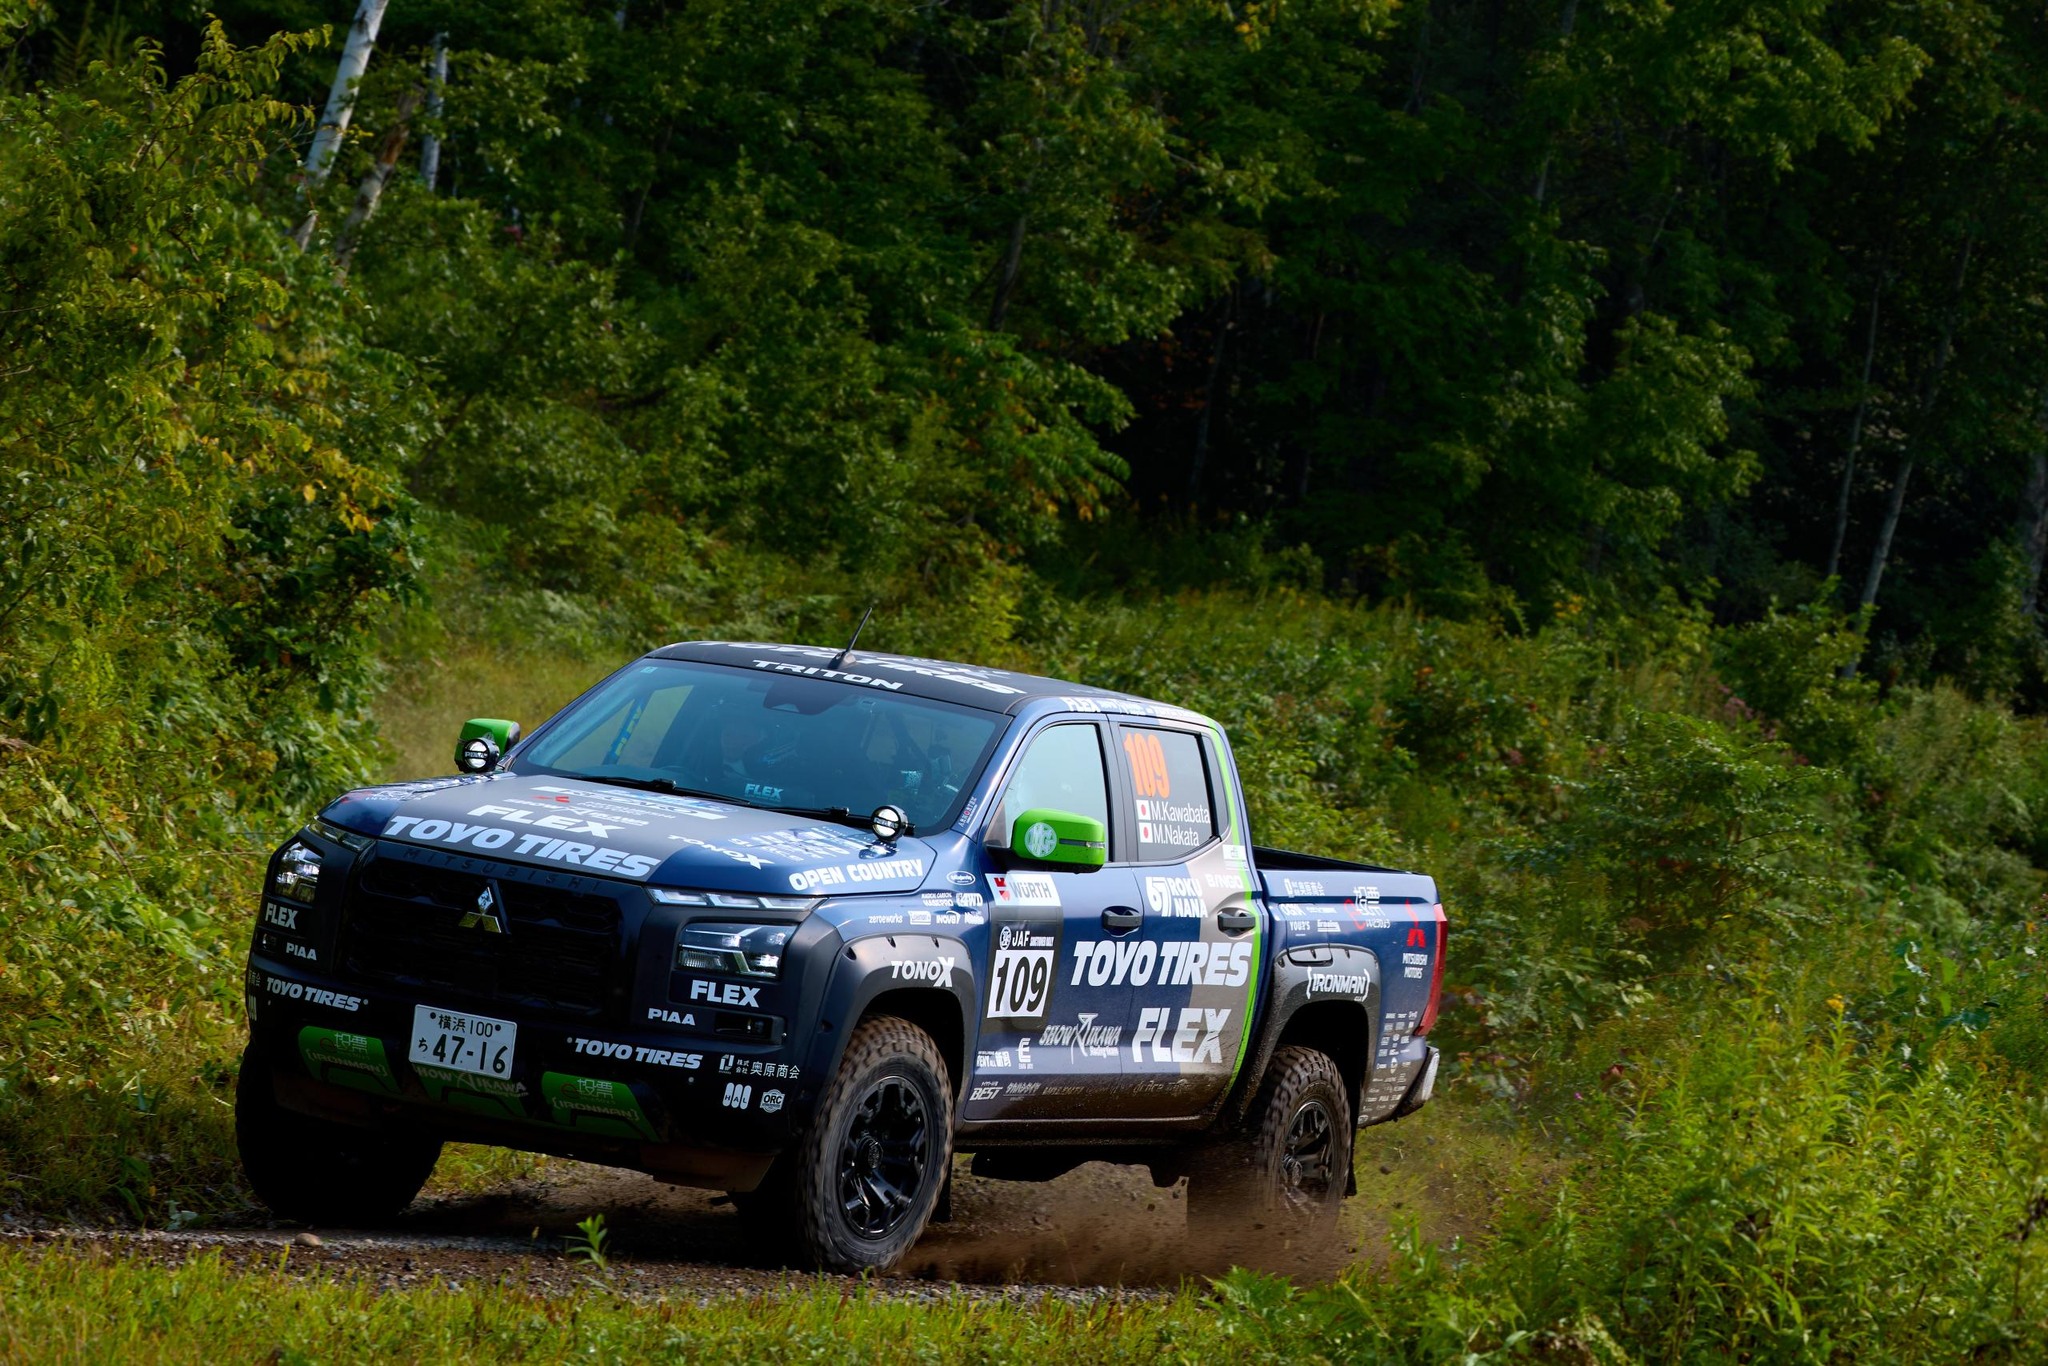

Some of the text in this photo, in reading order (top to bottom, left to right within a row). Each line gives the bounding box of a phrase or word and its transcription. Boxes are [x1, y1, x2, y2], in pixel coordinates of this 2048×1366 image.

[752, 659, 904, 691] TRITON
[1123, 732, 1170, 799] 109
[745, 783, 785, 803] FLEX
[467, 804, 626, 838] FLEX
[1150, 801, 1211, 824] M.Kawabata
[383, 815, 662, 878] TOYO TIRES
[1153, 823, 1200, 847] M.Nakata
[667, 834, 775, 870] TONOX
[788, 866, 846, 891] OPEN
[846, 859, 923, 883] COUNTRY
[1169, 876, 1203, 897] ROKU
[1205, 873, 1244, 889] BINGO
[265, 902, 298, 930] FLEX
[1173, 898, 1208, 918] NANA
[286, 942, 317, 961] PIAA
[1012, 931, 1031, 947] JAF
[891, 956, 955, 988] TONOX
[1070, 940, 1253, 987] TOYO TIRES
[267, 977, 361, 1012] TOYO TIRES
[690, 979, 761, 1008] FLEX
[995, 956, 1048, 1013] 109
[1312, 973, 1366, 994] IRONMAN
[438, 1014, 493, 1038] 横浜 100
[647, 1008, 696, 1026] PIAA
[1131, 1007, 1232, 1064] FLEX
[418, 1034, 508, 1074] ち 47-16
[574, 1038, 703, 1070] TOYO TIRES
[750, 1060, 801, 1080] 奥原商会
[764, 1095, 783, 1104] ORC
[970, 1086, 1004, 1101] BEST
